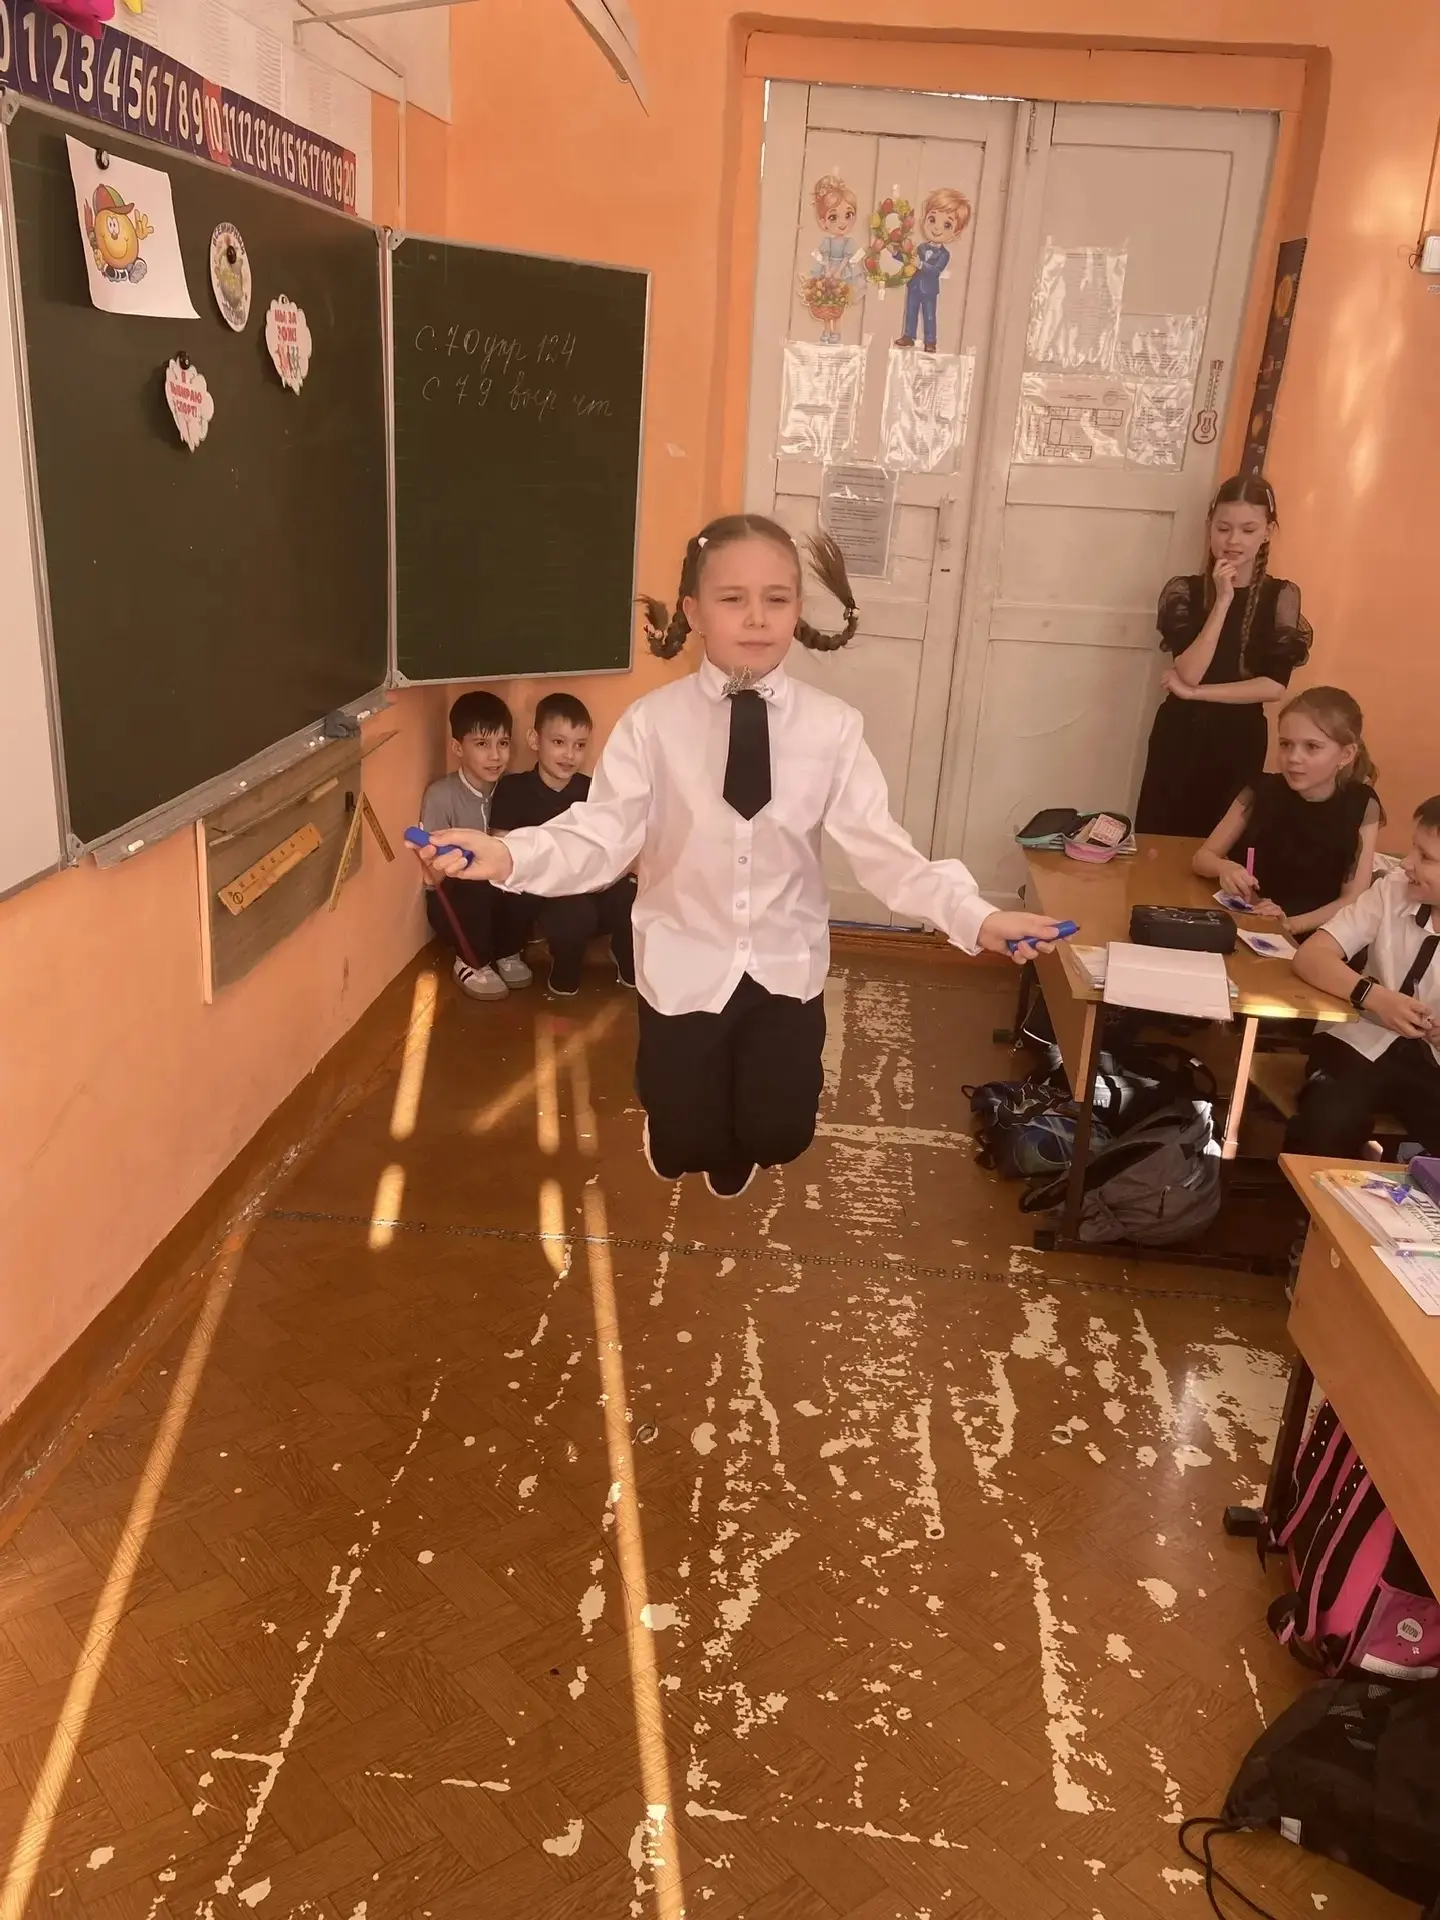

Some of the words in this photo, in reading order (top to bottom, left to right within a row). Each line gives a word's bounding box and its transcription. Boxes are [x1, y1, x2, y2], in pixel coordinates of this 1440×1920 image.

[23, 12, 37, 83] 1
[52, 23, 70, 94] 2
[79, 34, 95, 102] 3
[103, 47, 121, 112] 4
[128, 55, 143, 119] 5
[146, 65, 158, 127] 6
[163, 72, 174, 132] 7
[178, 80, 189, 140] 8
[192, 87, 203, 145] 9
[204, 95, 223, 154] 10
[222, 103, 239, 159] 11
[238, 110, 254, 166] 12
[254, 118, 266, 171] 13
[268, 125, 282, 177] 14
[282, 131, 296, 182] 15
[296, 138, 308, 188] 16
[308, 144, 320, 192] 17
[321, 150, 332, 198] 18
[333, 155, 343, 202] 19
[343, 160, 355, 207] 20
[181, 371, 187, 383] Я
